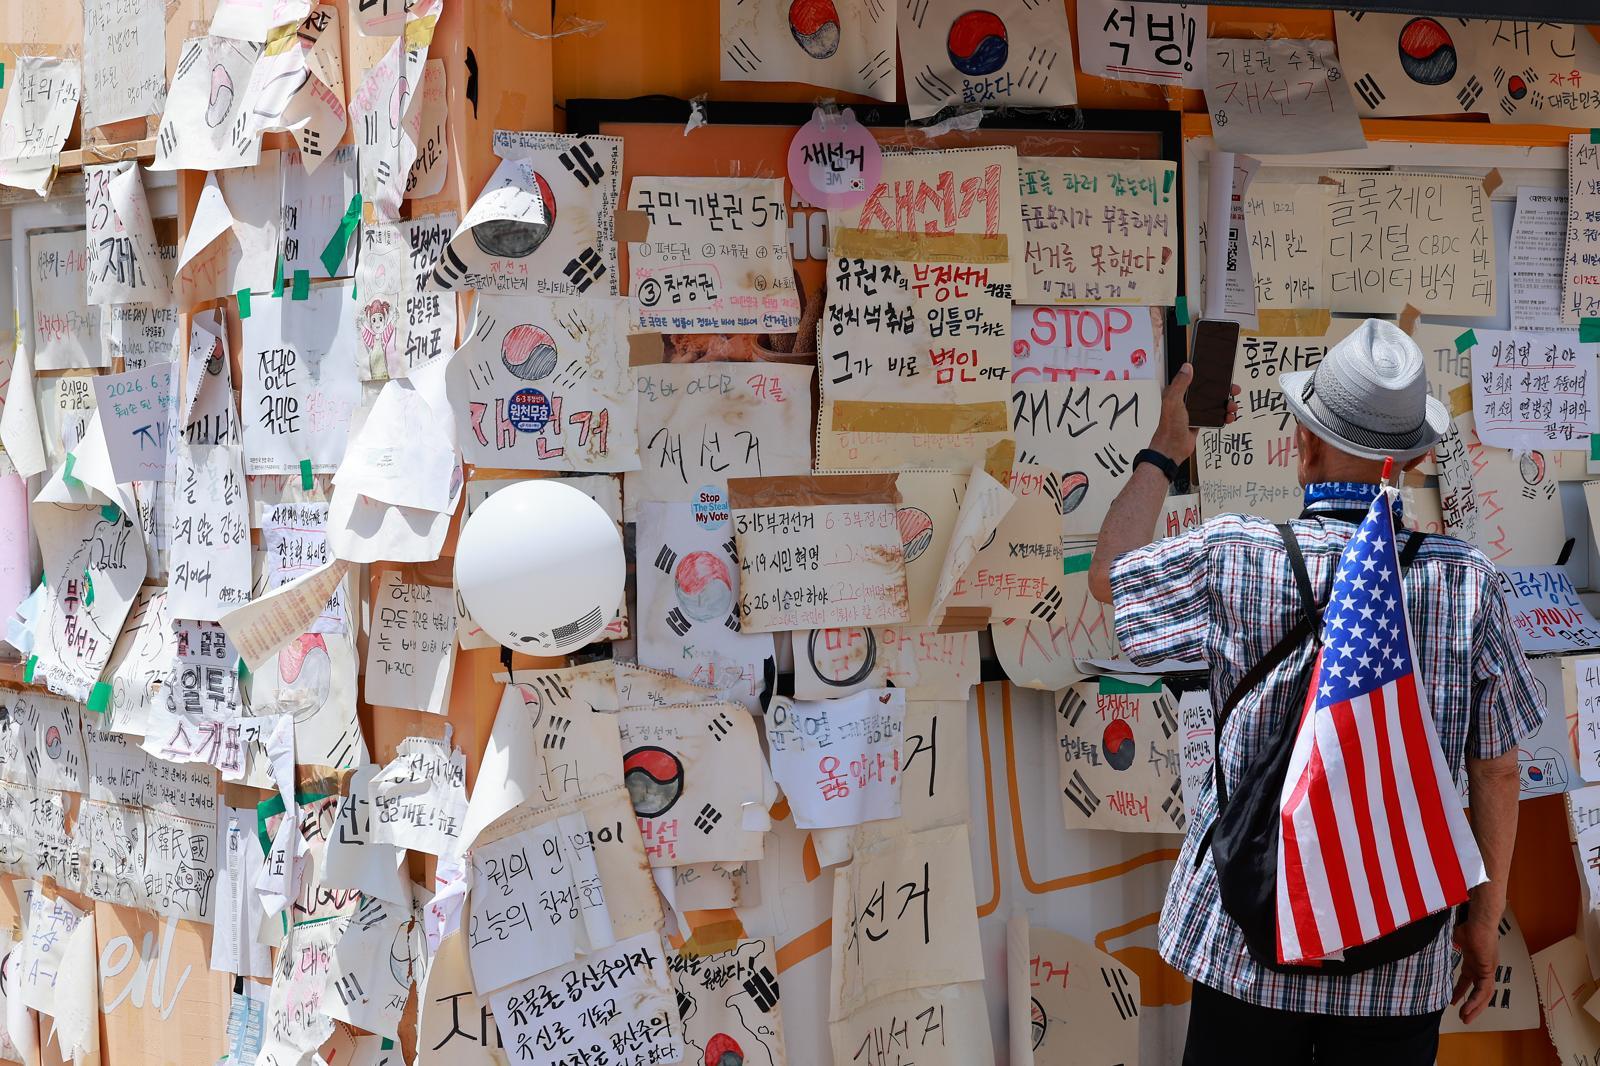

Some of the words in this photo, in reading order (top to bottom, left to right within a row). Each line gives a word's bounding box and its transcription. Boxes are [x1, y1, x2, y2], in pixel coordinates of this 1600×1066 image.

[1217, 49, 1276, 75] 기본권
[1548, 70, 1581, 88] 자유
[1025, 240, 1077, 275] 선거를
[664, 272, 718, 305] 참정권
[912, 263, 989, 303] 부정선거
[1031, 306, 1133, 352] STOP
[405, 328, 441, 368] 수개표
[888, 356, 920, 378] 바로
[510, 403, 549, 421] 원천무효
[1012, 386, 1139, 438] 재선거
[693, 503, 707, 512] The
[709, 502, 728, 511] Steal
[700, 493, 720, 503] Stop
[695, 512, 709, 523] My
[711, 512, 728, 521] Vote
[1097, 692, 1140, 722] 부정선거
[1107, 790, 1150, 822] 재선거
